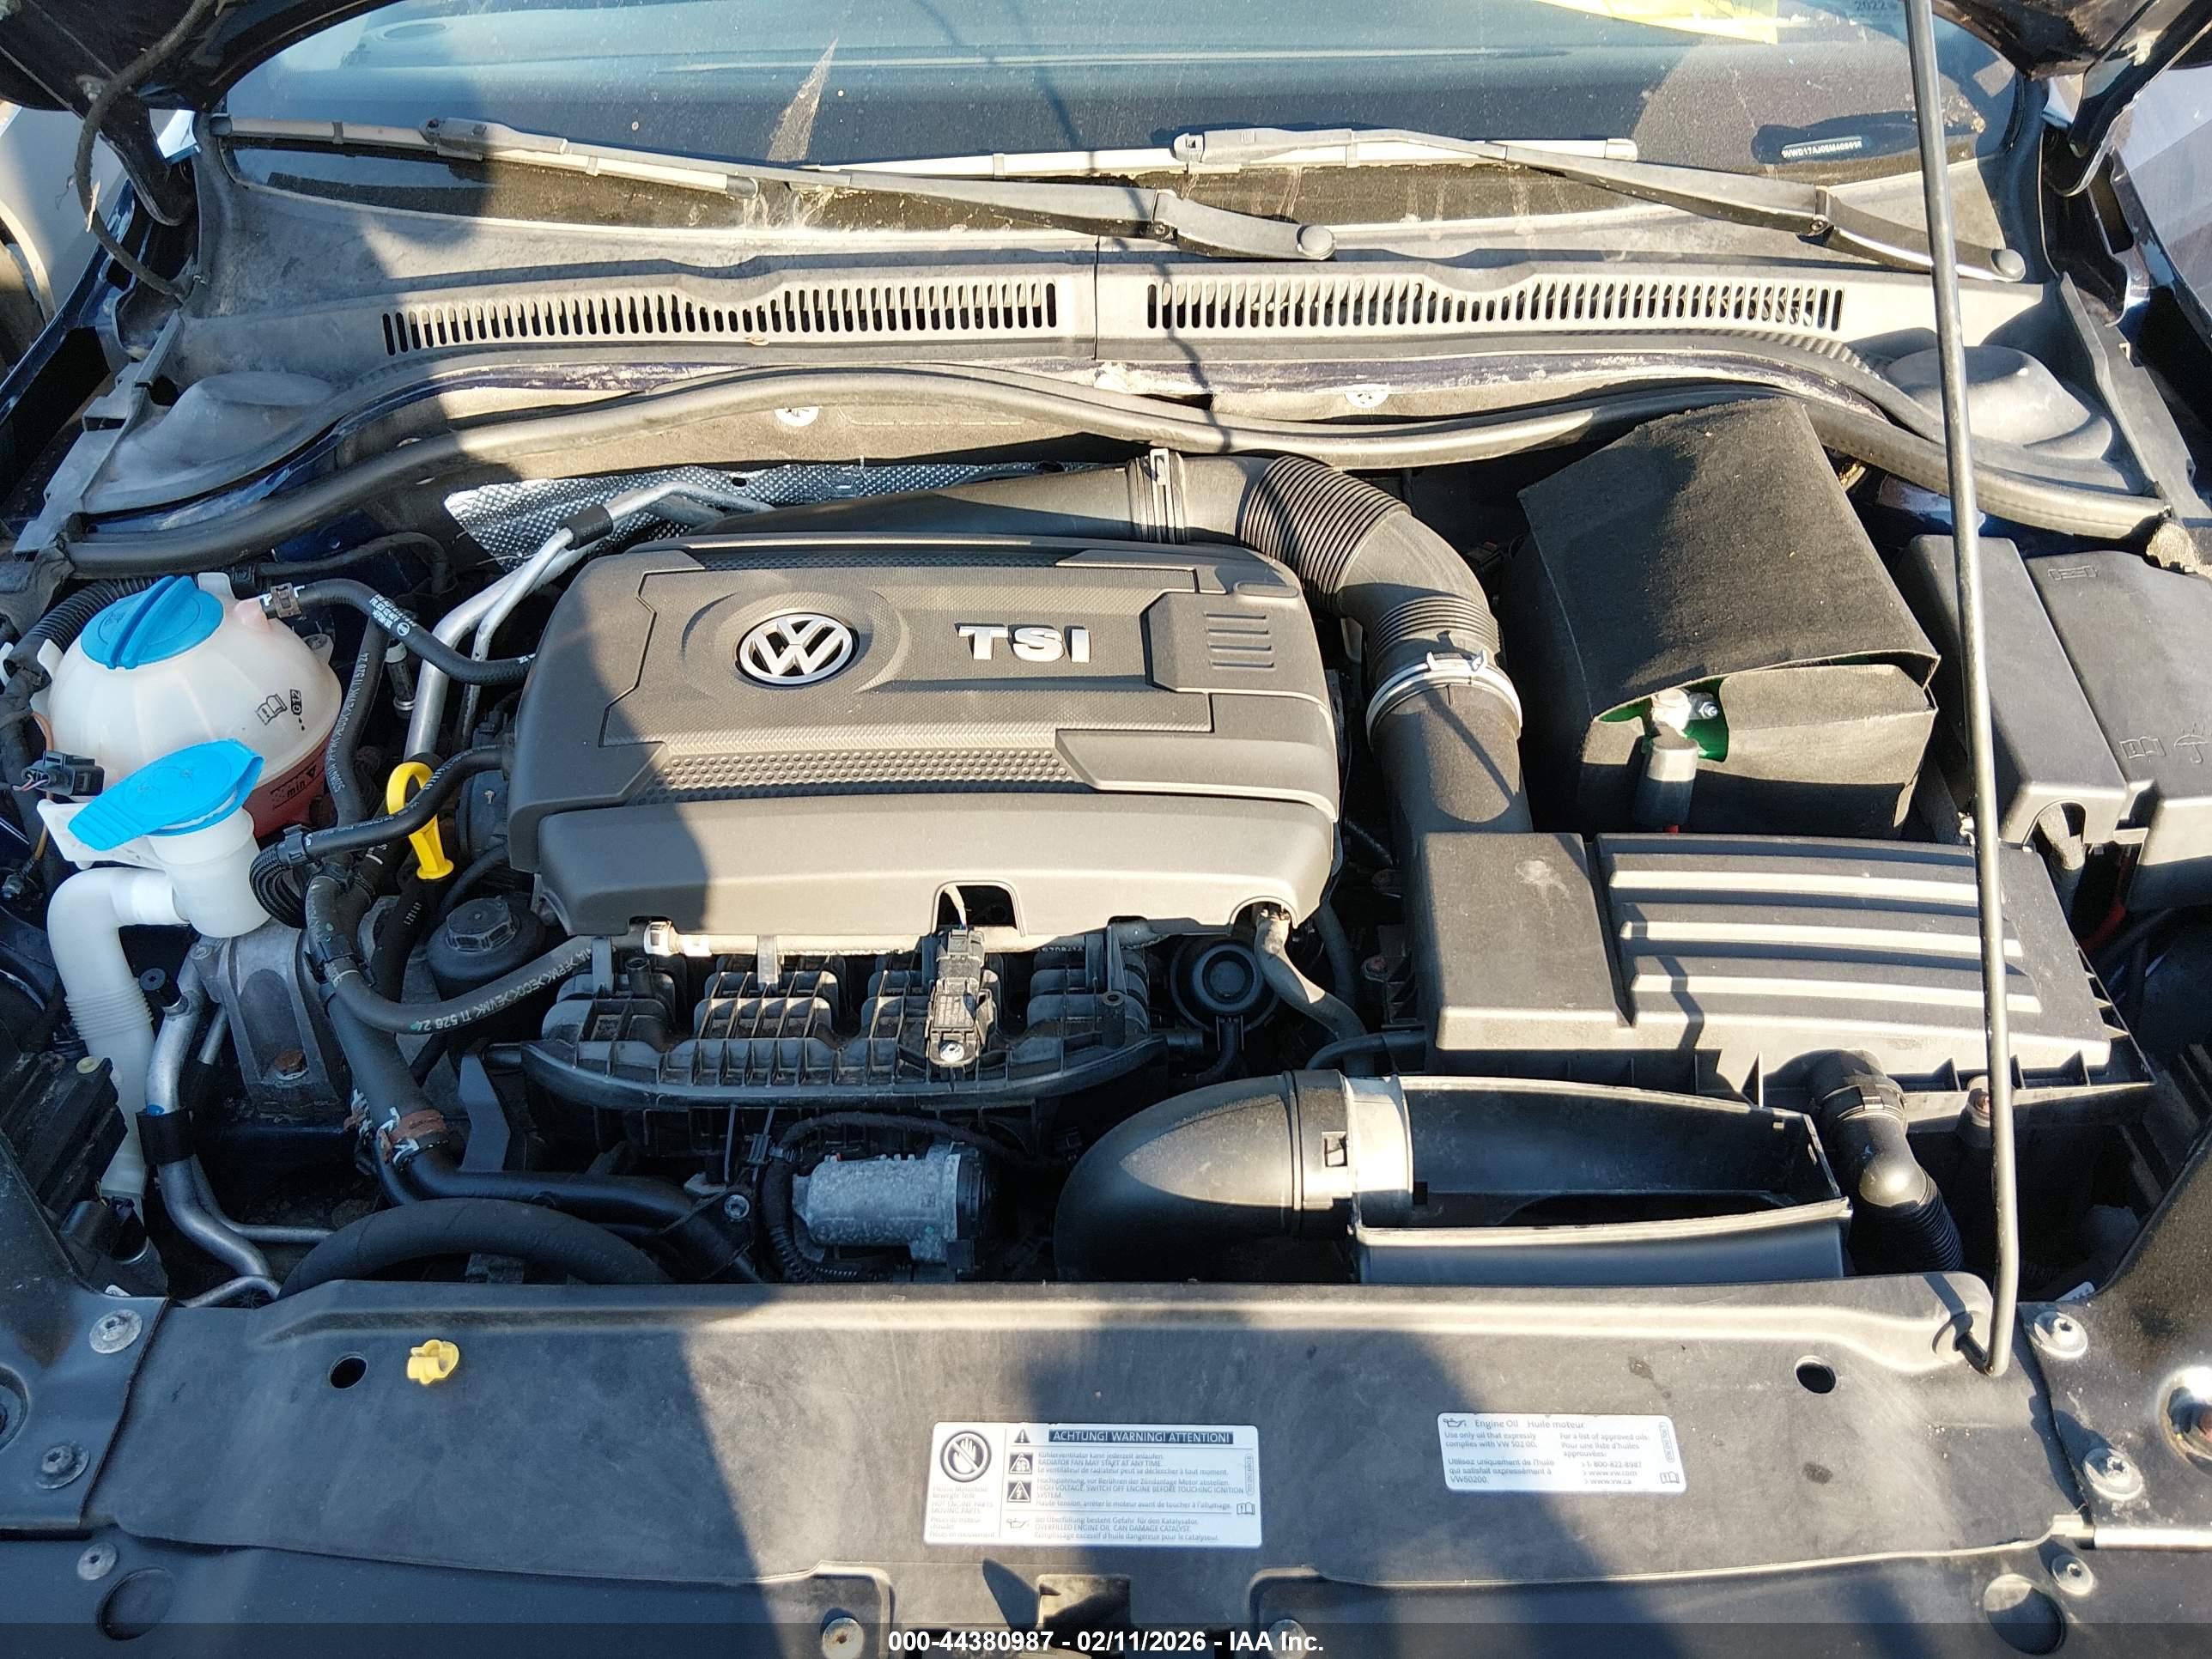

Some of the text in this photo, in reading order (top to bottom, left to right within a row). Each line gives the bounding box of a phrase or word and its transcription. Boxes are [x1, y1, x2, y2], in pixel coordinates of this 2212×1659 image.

[958, 624, 1091, 664] TSI
[290, 690, 302, 714] G12
[286, 781, 307, 798] min
[1475, 1420, 1504, 1429] Engine
[1527, 1420, 1551, 1429] Huile
[1053, 1431, 1230, 1443] ACHTUNG! WARNING! ATTENTION!
[1444, 1431, 1536, 1441] Use only oil that expressly
